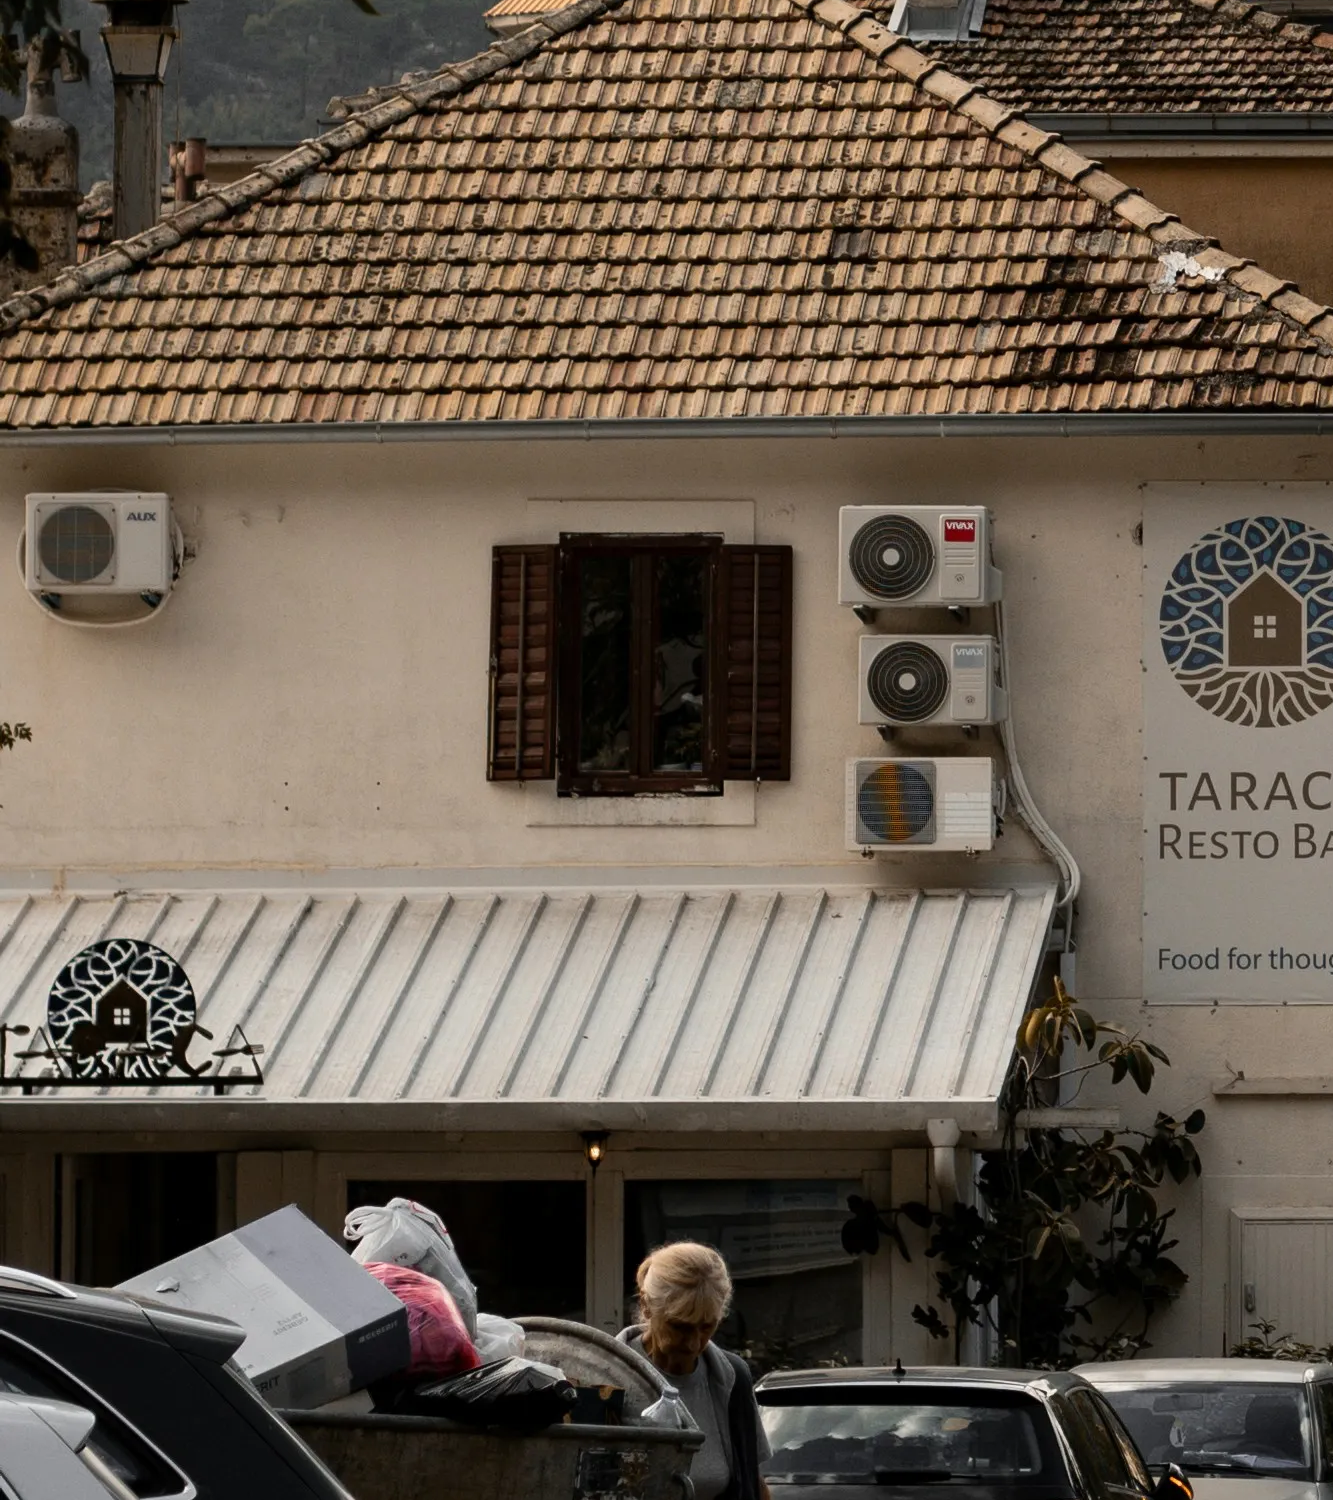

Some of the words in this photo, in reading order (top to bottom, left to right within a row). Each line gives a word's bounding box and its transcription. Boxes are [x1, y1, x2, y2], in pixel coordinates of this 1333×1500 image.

[127, 512, 157, 522] AUX
[945, 522, 975, 531] VIVAX
[955, 648, 984, 657] VIVAX
[1159, 823, 1279, 860] RESTO
[1158, 947, 1220, 971] Food
[1227, 947, 1262, 970] for
